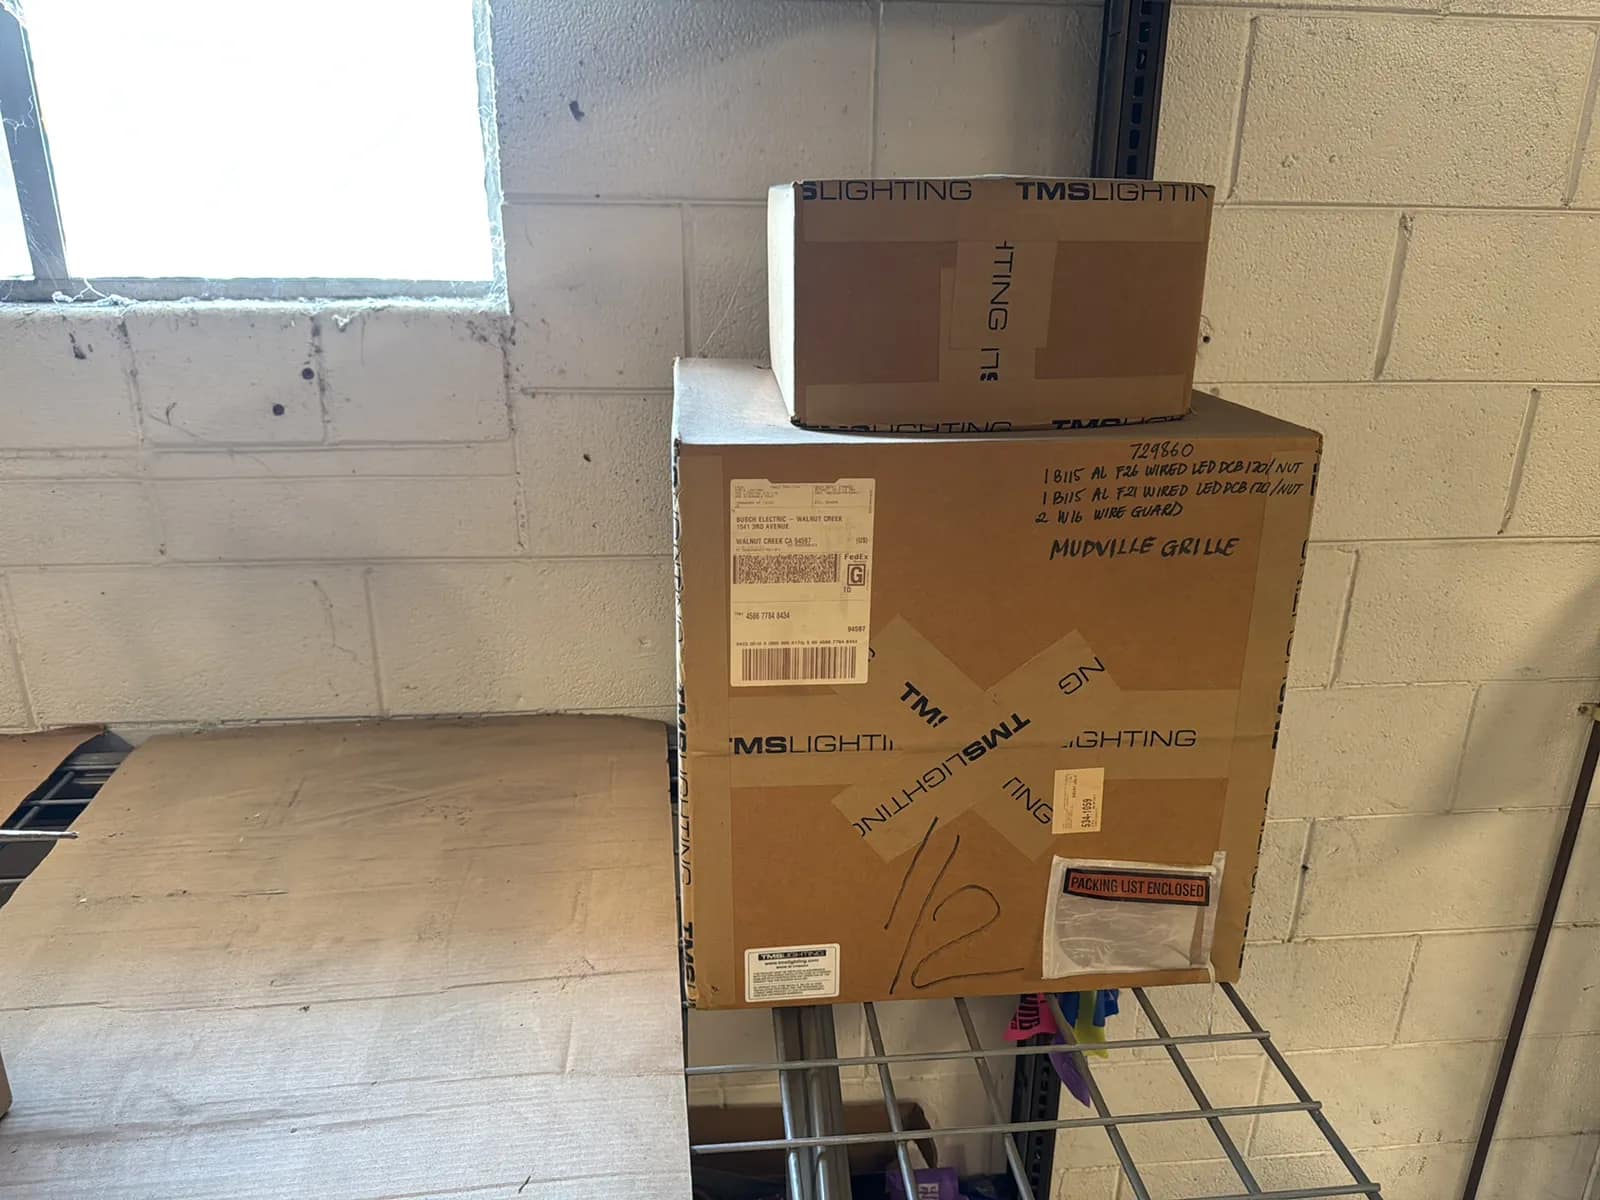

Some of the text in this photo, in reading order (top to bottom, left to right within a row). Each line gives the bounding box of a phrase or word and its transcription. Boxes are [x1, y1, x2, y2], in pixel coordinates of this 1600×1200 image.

[1130, 441, 1194, 460] 729860
[1044, 468, 1049, 484] 1
[1091, 466, 1107, 480] AL
[1145, 463, 1188, 477] WIRED
[1192, 460, 1217, 475] LED
[1043, 491, 1047, 505] 1
[1092, 488, 1109, 502] AL
[1117, 487, 1137, 500] F21
[1143, 485, 1189, 498] WIRED
[1196, 481, 1223, 496] LED
[1035, 511, 1048, 523] 2
[1094, 505, 1127, 520] WIRE
[1131, 501, 1183, 518] GUARD
[735, 537, 761, 545] WALNUT
[763, 537, 783, 545] CREEK
[1049, 536, 1240, 560] MUDVILLE GRILLE
[850, 566, 863, 583] G
[1070, 876, 1204, 898] PACKING LIST ENCLOSED
